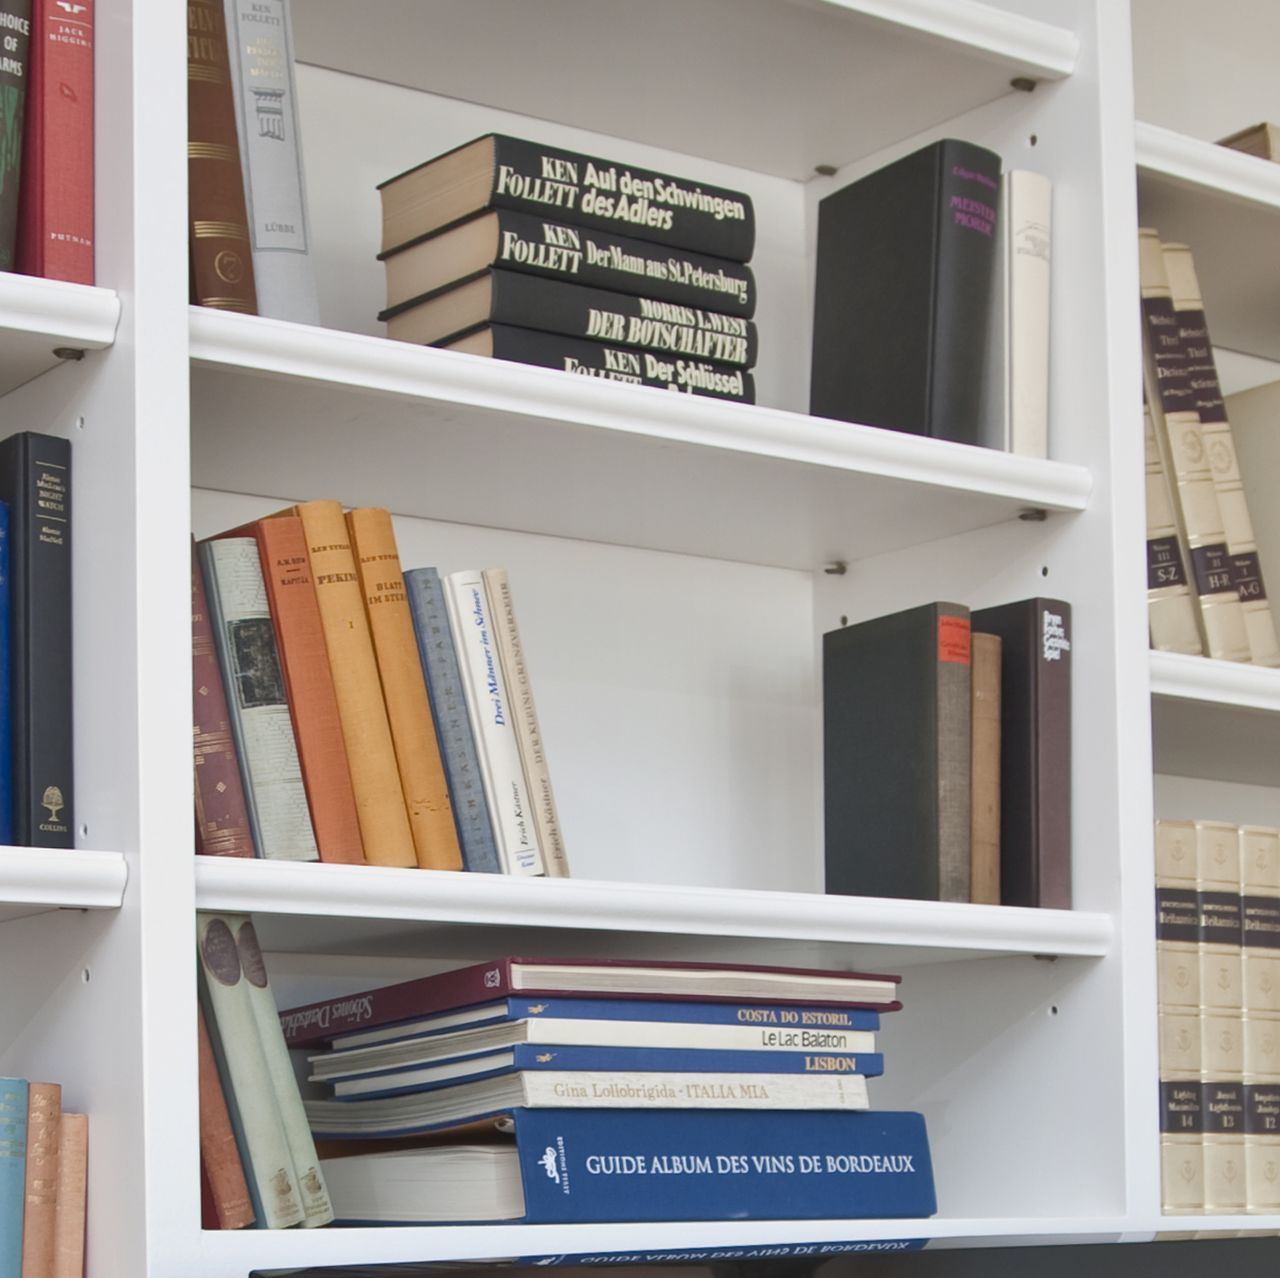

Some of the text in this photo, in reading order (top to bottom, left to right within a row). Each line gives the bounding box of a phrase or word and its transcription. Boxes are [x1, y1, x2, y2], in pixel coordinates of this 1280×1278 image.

[4, 36, 18, 51] OF
[59, 25, 84, 37] JACK
[541, 155, 578, 184] KEN
[496, 165, 579, 209] FOLLETT
[583, 162, 746, 221] Auf den Schwingen
[581, 189, 673, 230] des Adlers
[542, 223, 581, 249] KEN
[501, 230, 583, 274] FOLLETT
[586, 240, 611, 267] Der
[610, 246, 645, 275] Mann
[646, 259, 667, 280] aus
[639, 298, 696, 327] MORRIS
[586, 308, 748, 364] DER BOTSCHAFTER
[604, 348, 641, 375] KEN
[644, 354, 744, 397] Der Schlüssel
[1158, 568, 1178, 582] S-Z
[472, 587, 485, 627] Schnee
[480, 629, 490, 645] im
[484, 647, 499, 695] Männer
[491, 698, 506, 727] Drei
[737, 1008, 852, 1027] COSTA DO ESTORIL
[761, 1031, 847, 1048] Le Lac Balaton
[804, 1056, 857, 1071] LISBON
[553, 1081, 769, 1101] Gina Lollobrigida ITALIA MIA
[1181, 1115, 1193, 1127] 14
[1223, 1115, 1234, 1127] 13
[1265, 1117, 1276, 1129] 12
[586, 1154, 915, 1175] GUIDE ALBUM DES VINS DE BORDEAUX
